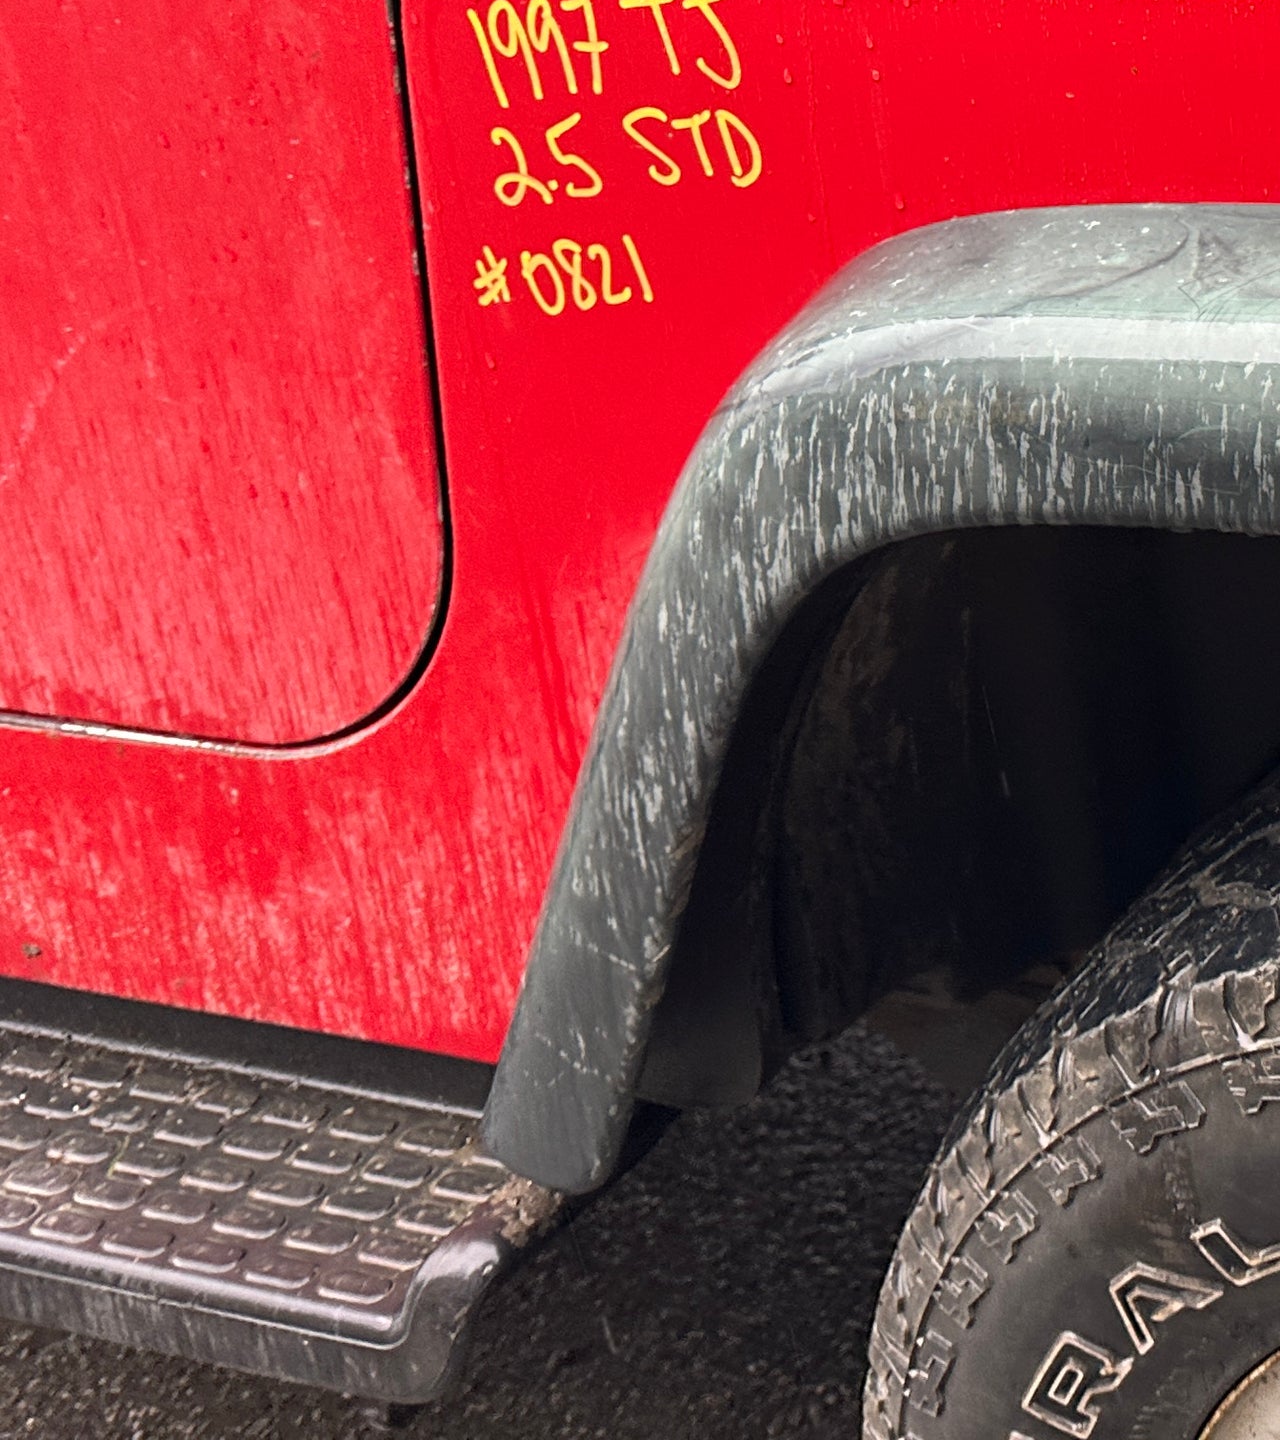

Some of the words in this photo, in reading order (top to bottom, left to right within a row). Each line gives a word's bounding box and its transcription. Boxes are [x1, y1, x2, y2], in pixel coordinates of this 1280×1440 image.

[491, 113, 603, 207] 2.5
[622, 106, 763, 188] STD
[473, 234, 655, 316] #0821
